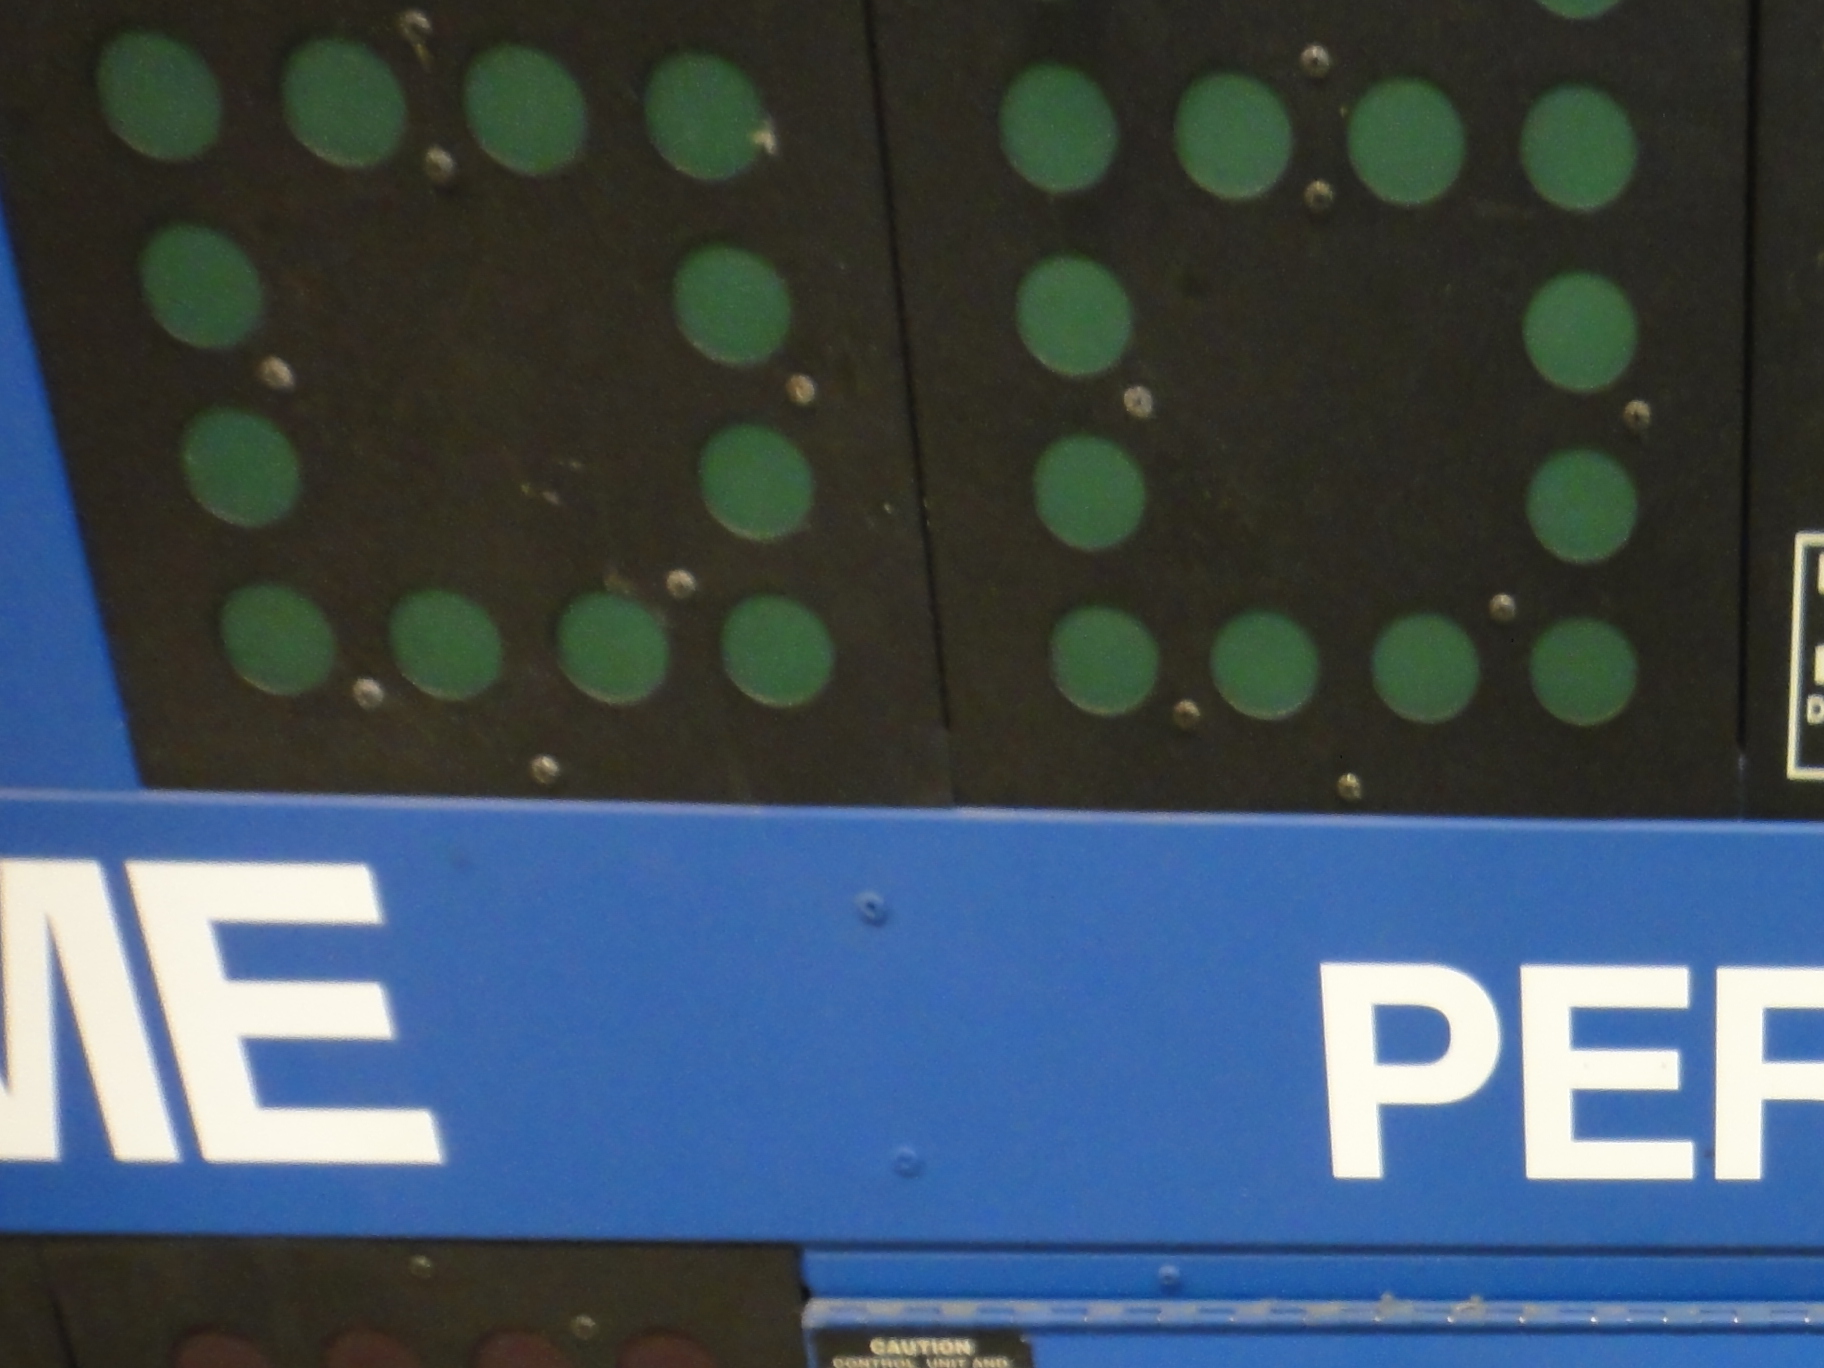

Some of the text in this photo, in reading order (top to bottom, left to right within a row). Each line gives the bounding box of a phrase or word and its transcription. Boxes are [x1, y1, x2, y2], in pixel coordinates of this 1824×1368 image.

[869, 1337, 972, 1356] CAUTION
[832, 1357, 1008, 1368] CONTROL UNIT AND
